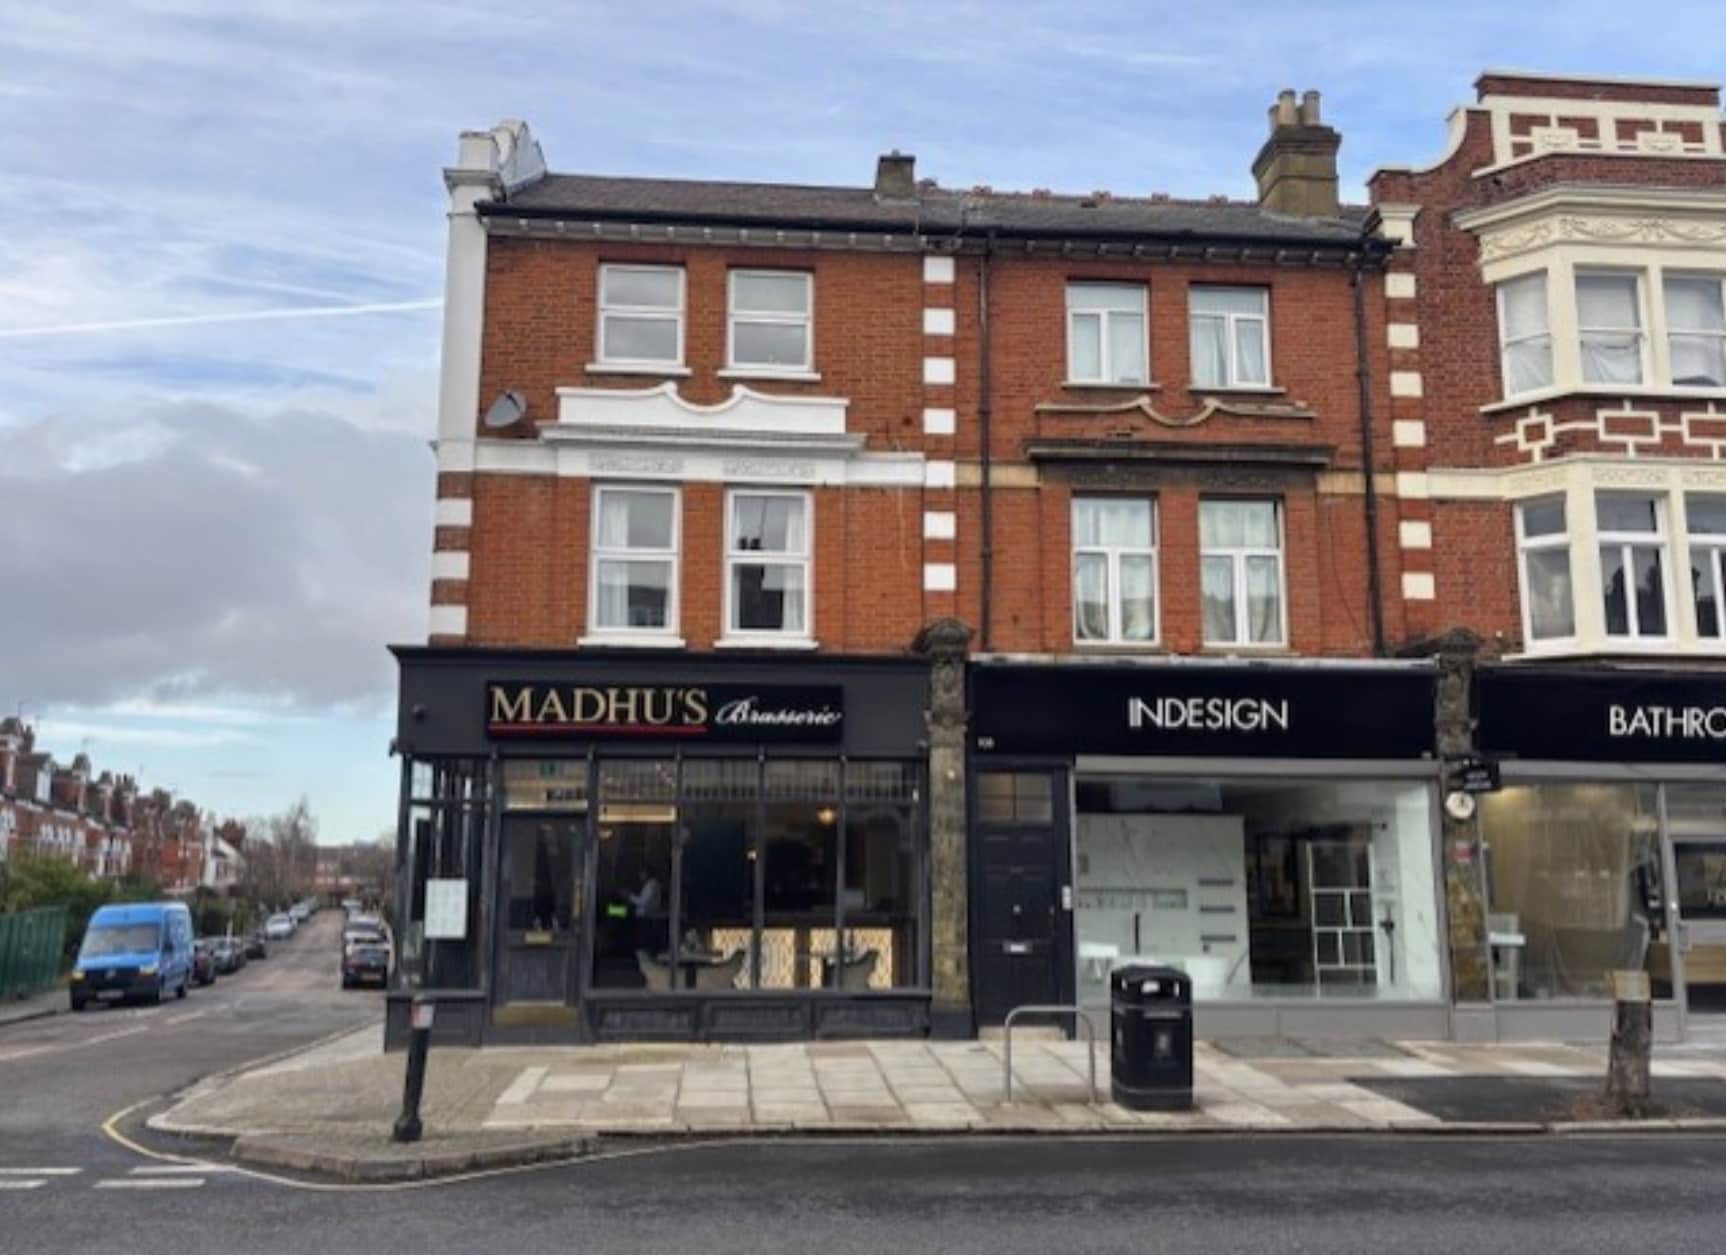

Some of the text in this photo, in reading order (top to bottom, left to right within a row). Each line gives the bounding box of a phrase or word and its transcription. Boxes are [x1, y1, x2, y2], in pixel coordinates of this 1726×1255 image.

[490, 686, 842, 726] MADHU'S Brasserie
[1128, 697, 1289, 730] INDESIGN
